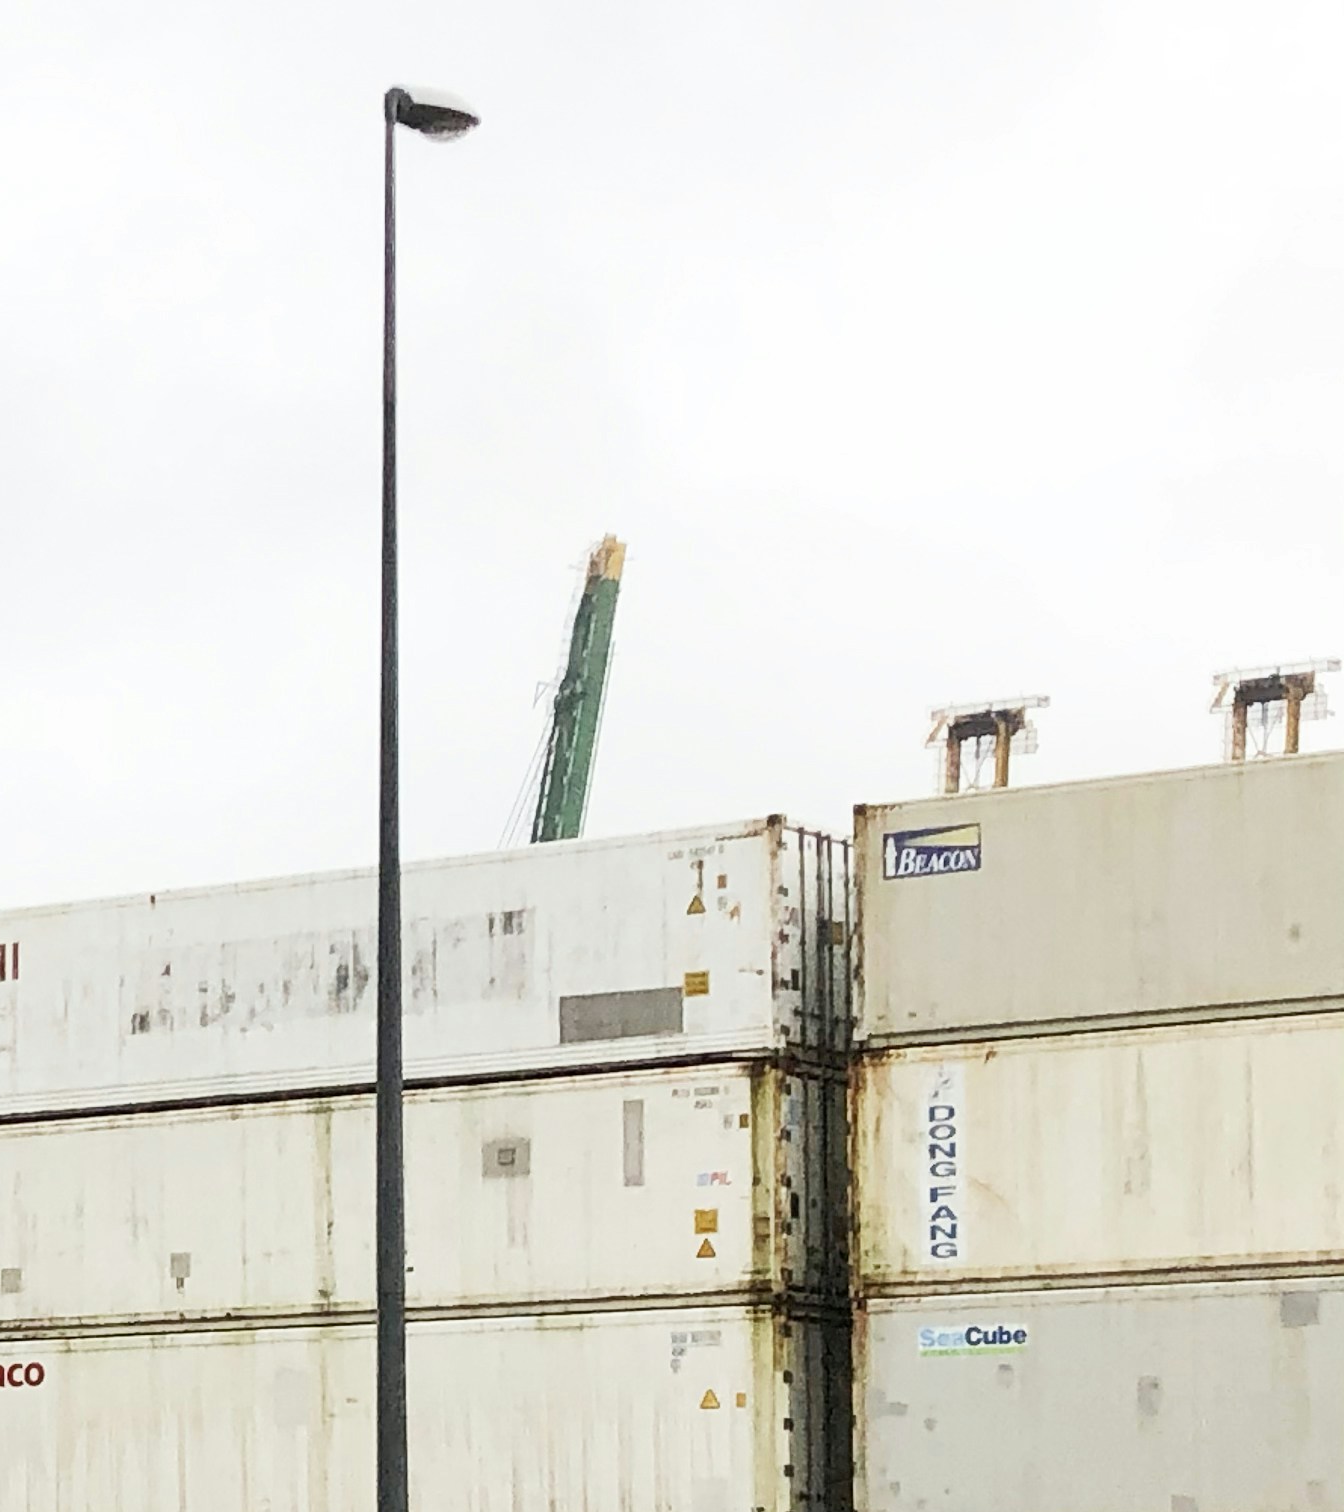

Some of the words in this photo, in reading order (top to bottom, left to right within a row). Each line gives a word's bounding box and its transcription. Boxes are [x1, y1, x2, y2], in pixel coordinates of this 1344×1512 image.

[896, 847, 979, 877] BEACON
[928, 1104, 957, 1178] DONG
[929, 1186, 958, 1259] FANG
[919, 1325, 1028, 1347] SeaCube
